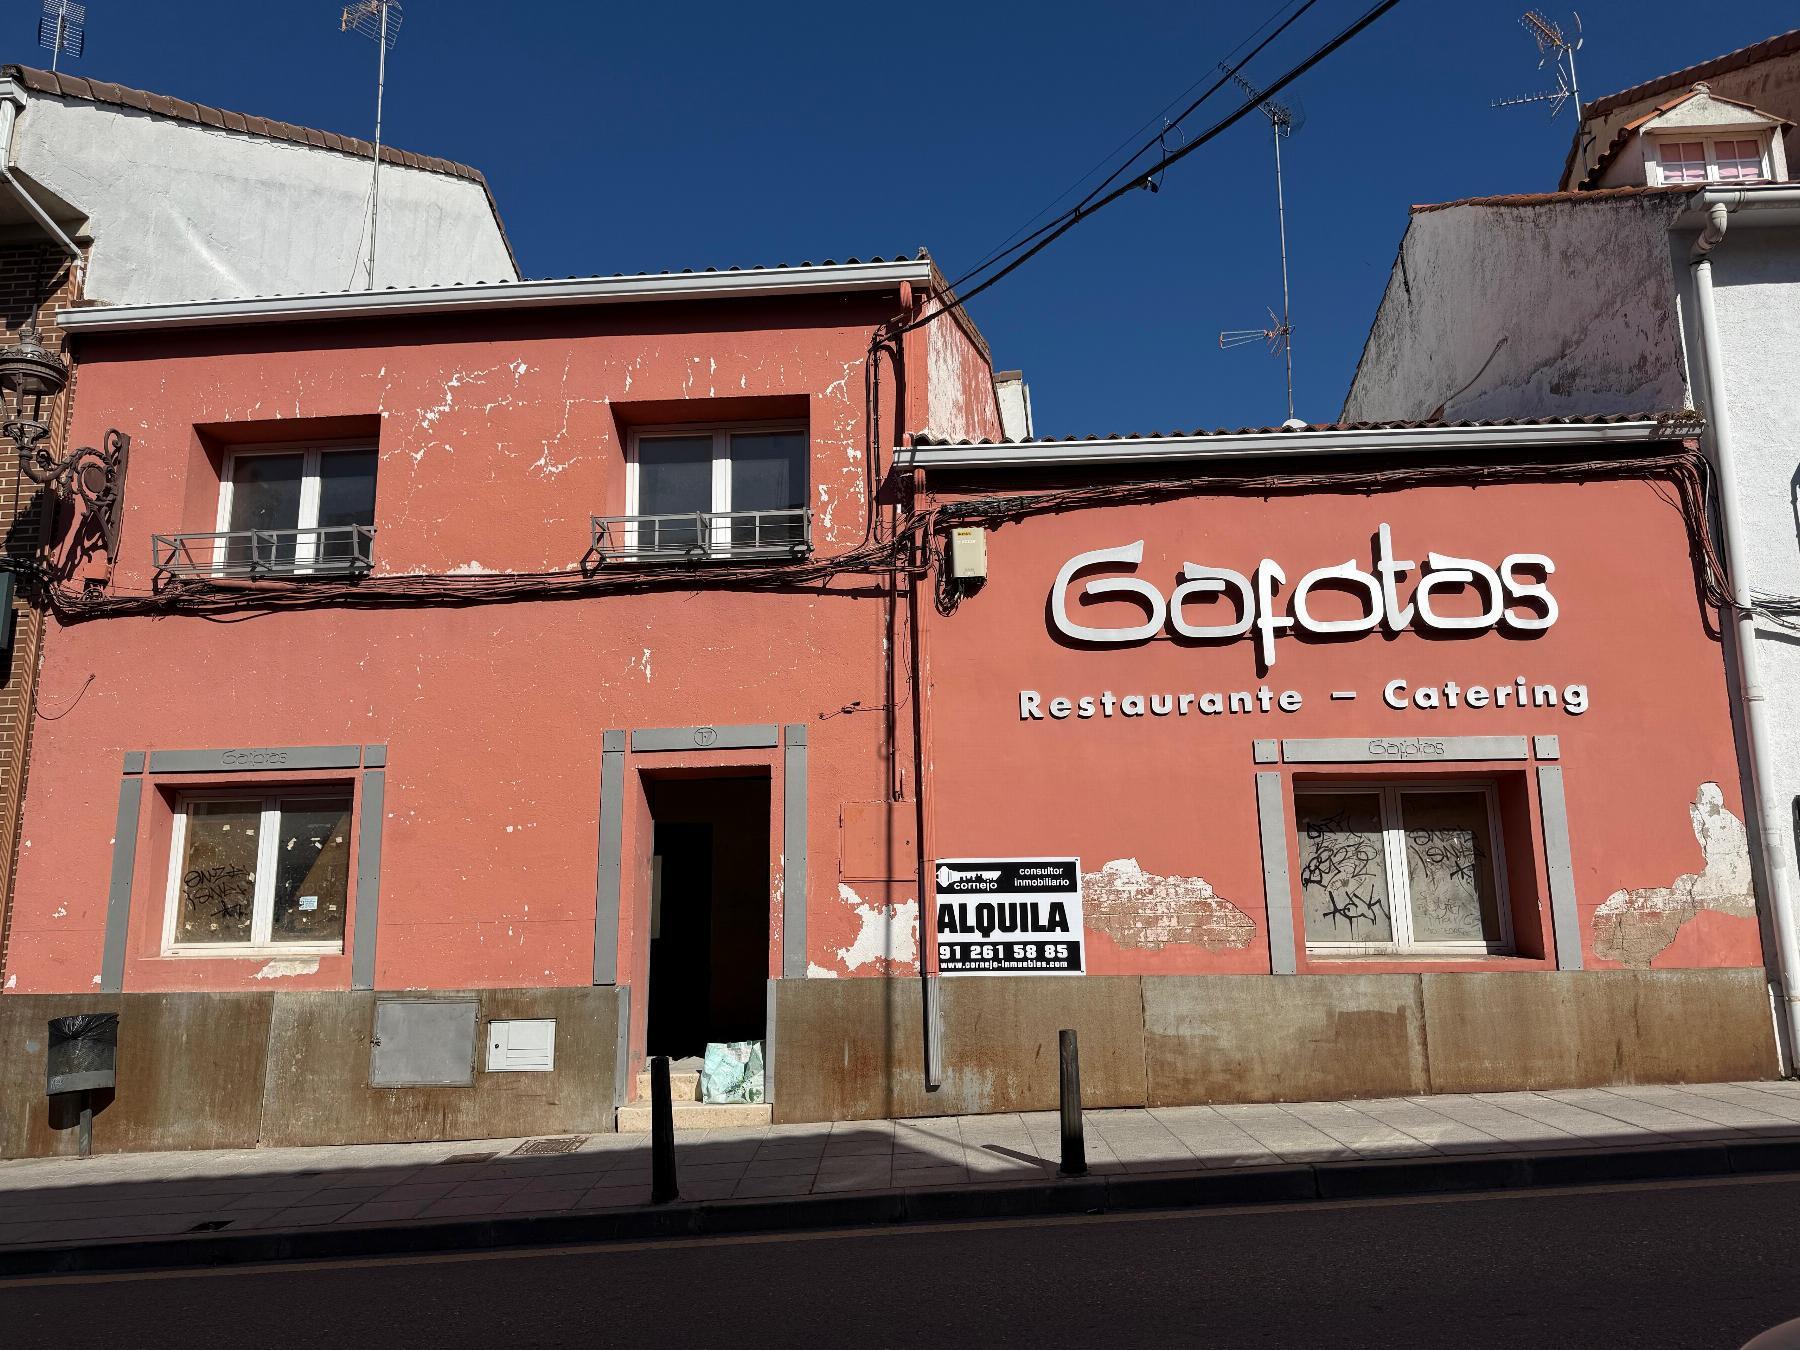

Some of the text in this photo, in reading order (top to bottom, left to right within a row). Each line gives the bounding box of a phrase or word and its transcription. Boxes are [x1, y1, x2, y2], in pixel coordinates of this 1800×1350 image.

[1051, 522, 1560, 667] Gafotas
[1019, 685, 1303, 719] Restaurante
[1383, 675, 1589, 714] Catering
[1368, 737, 1445, 760] Gafotas
[1019, 866, 1064, 875] consultor
[953, 880, 998, 892] cornejo
[1014, 877, 1070, 887] inmobiliario
[937, 901, 1070, 938] ALQUILA
[939, 944, 1068, 960] 91 261 58 85
[940, 960, 1068, 970] www.cornejo-inmuebles.com
